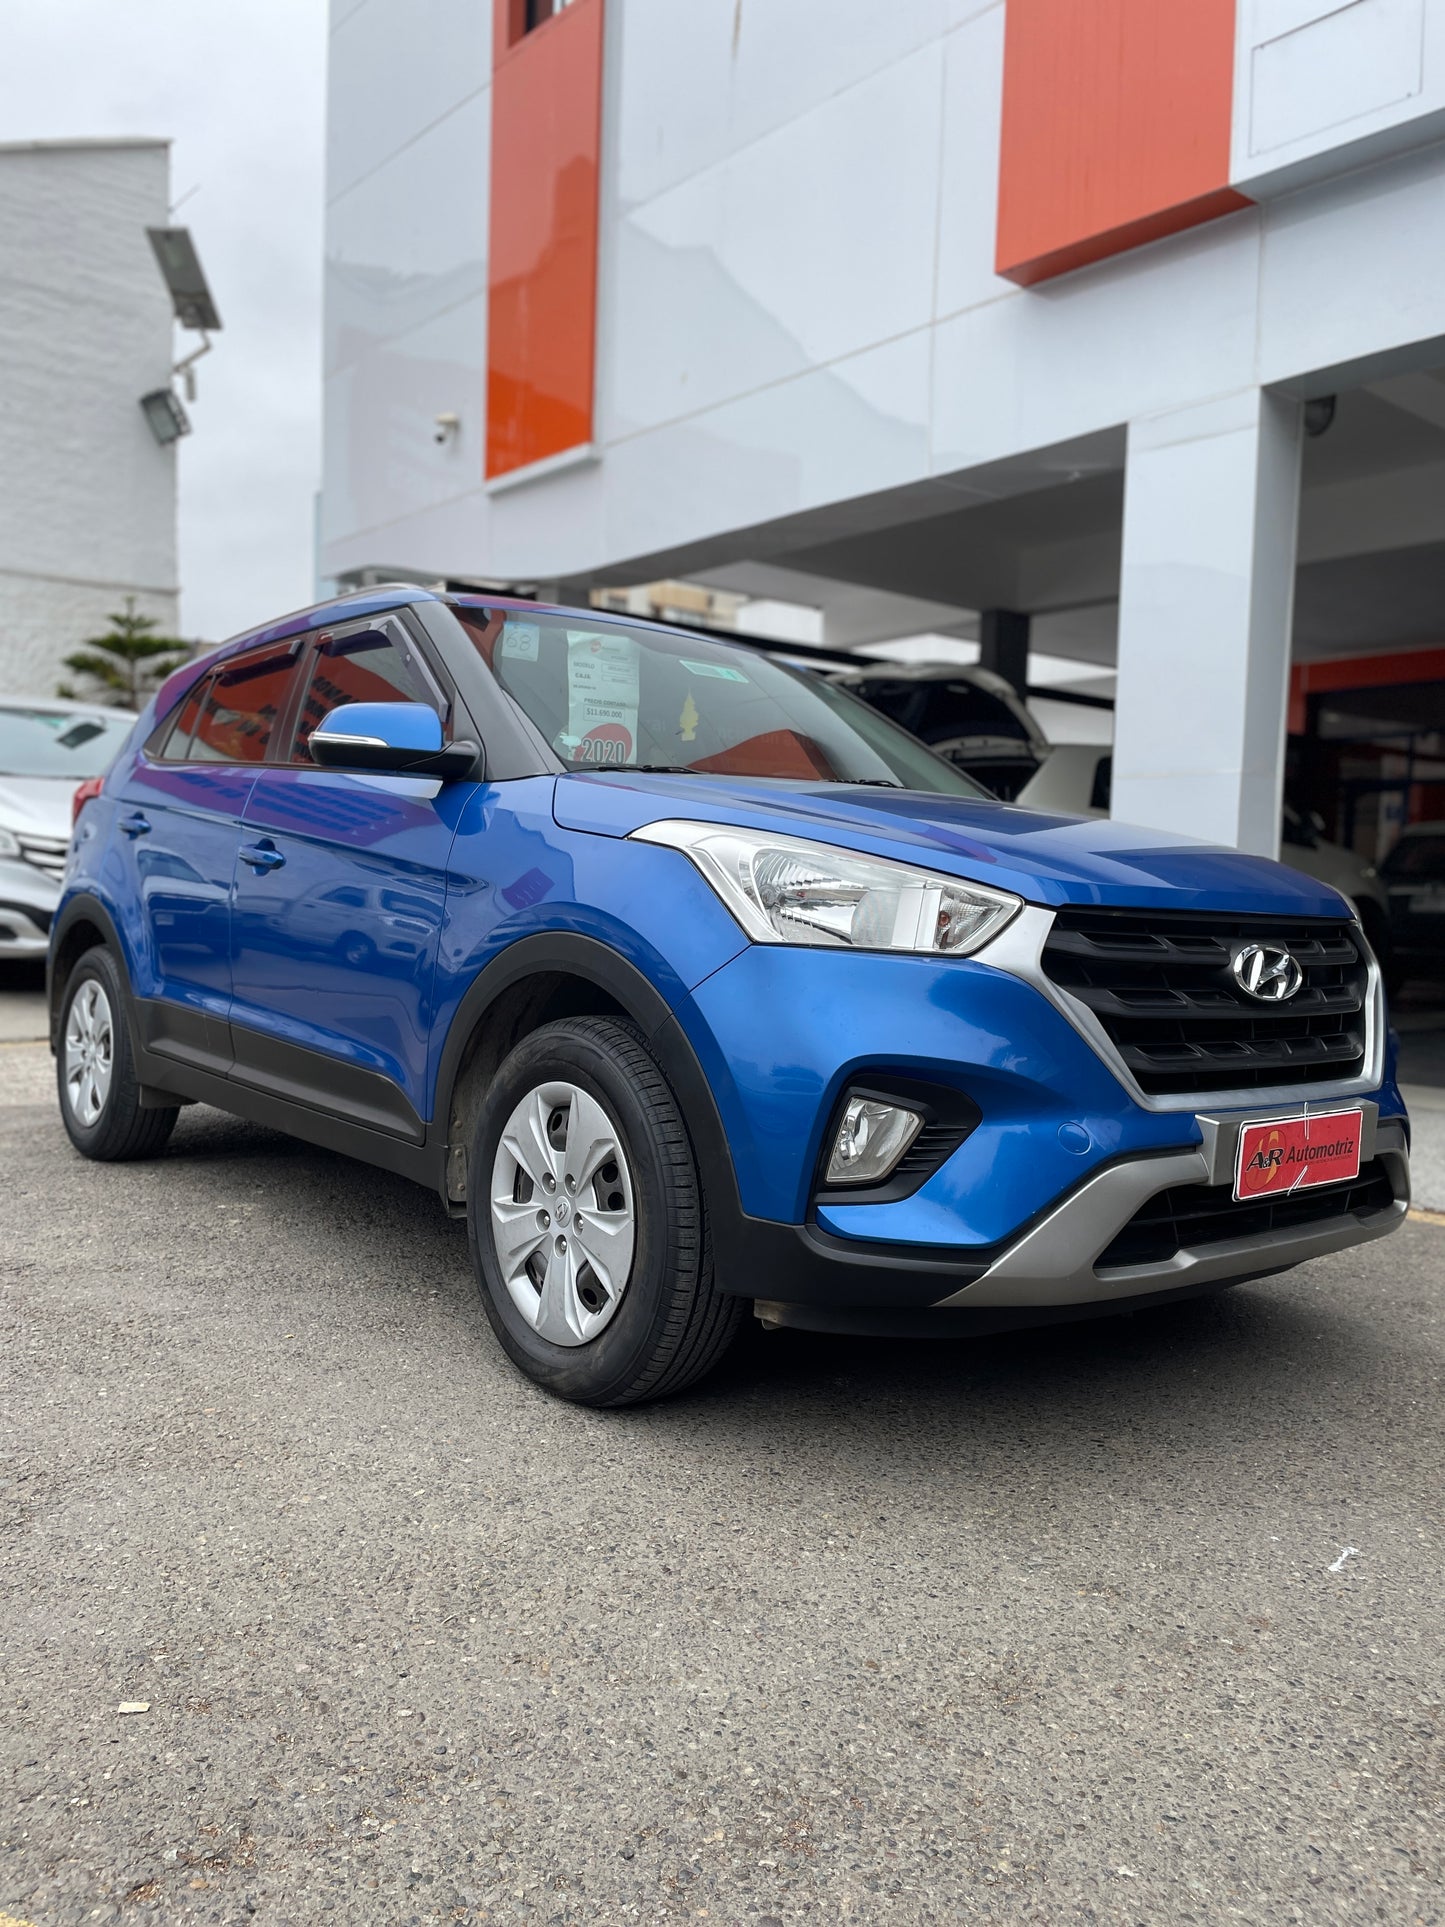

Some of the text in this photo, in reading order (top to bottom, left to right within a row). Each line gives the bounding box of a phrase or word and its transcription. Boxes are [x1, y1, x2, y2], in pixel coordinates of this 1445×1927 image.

[506, 631, 531, 651] 68
[582, 738, 625, 763] 2020
[1286, 1137, 1354, 1164] Automotriz
